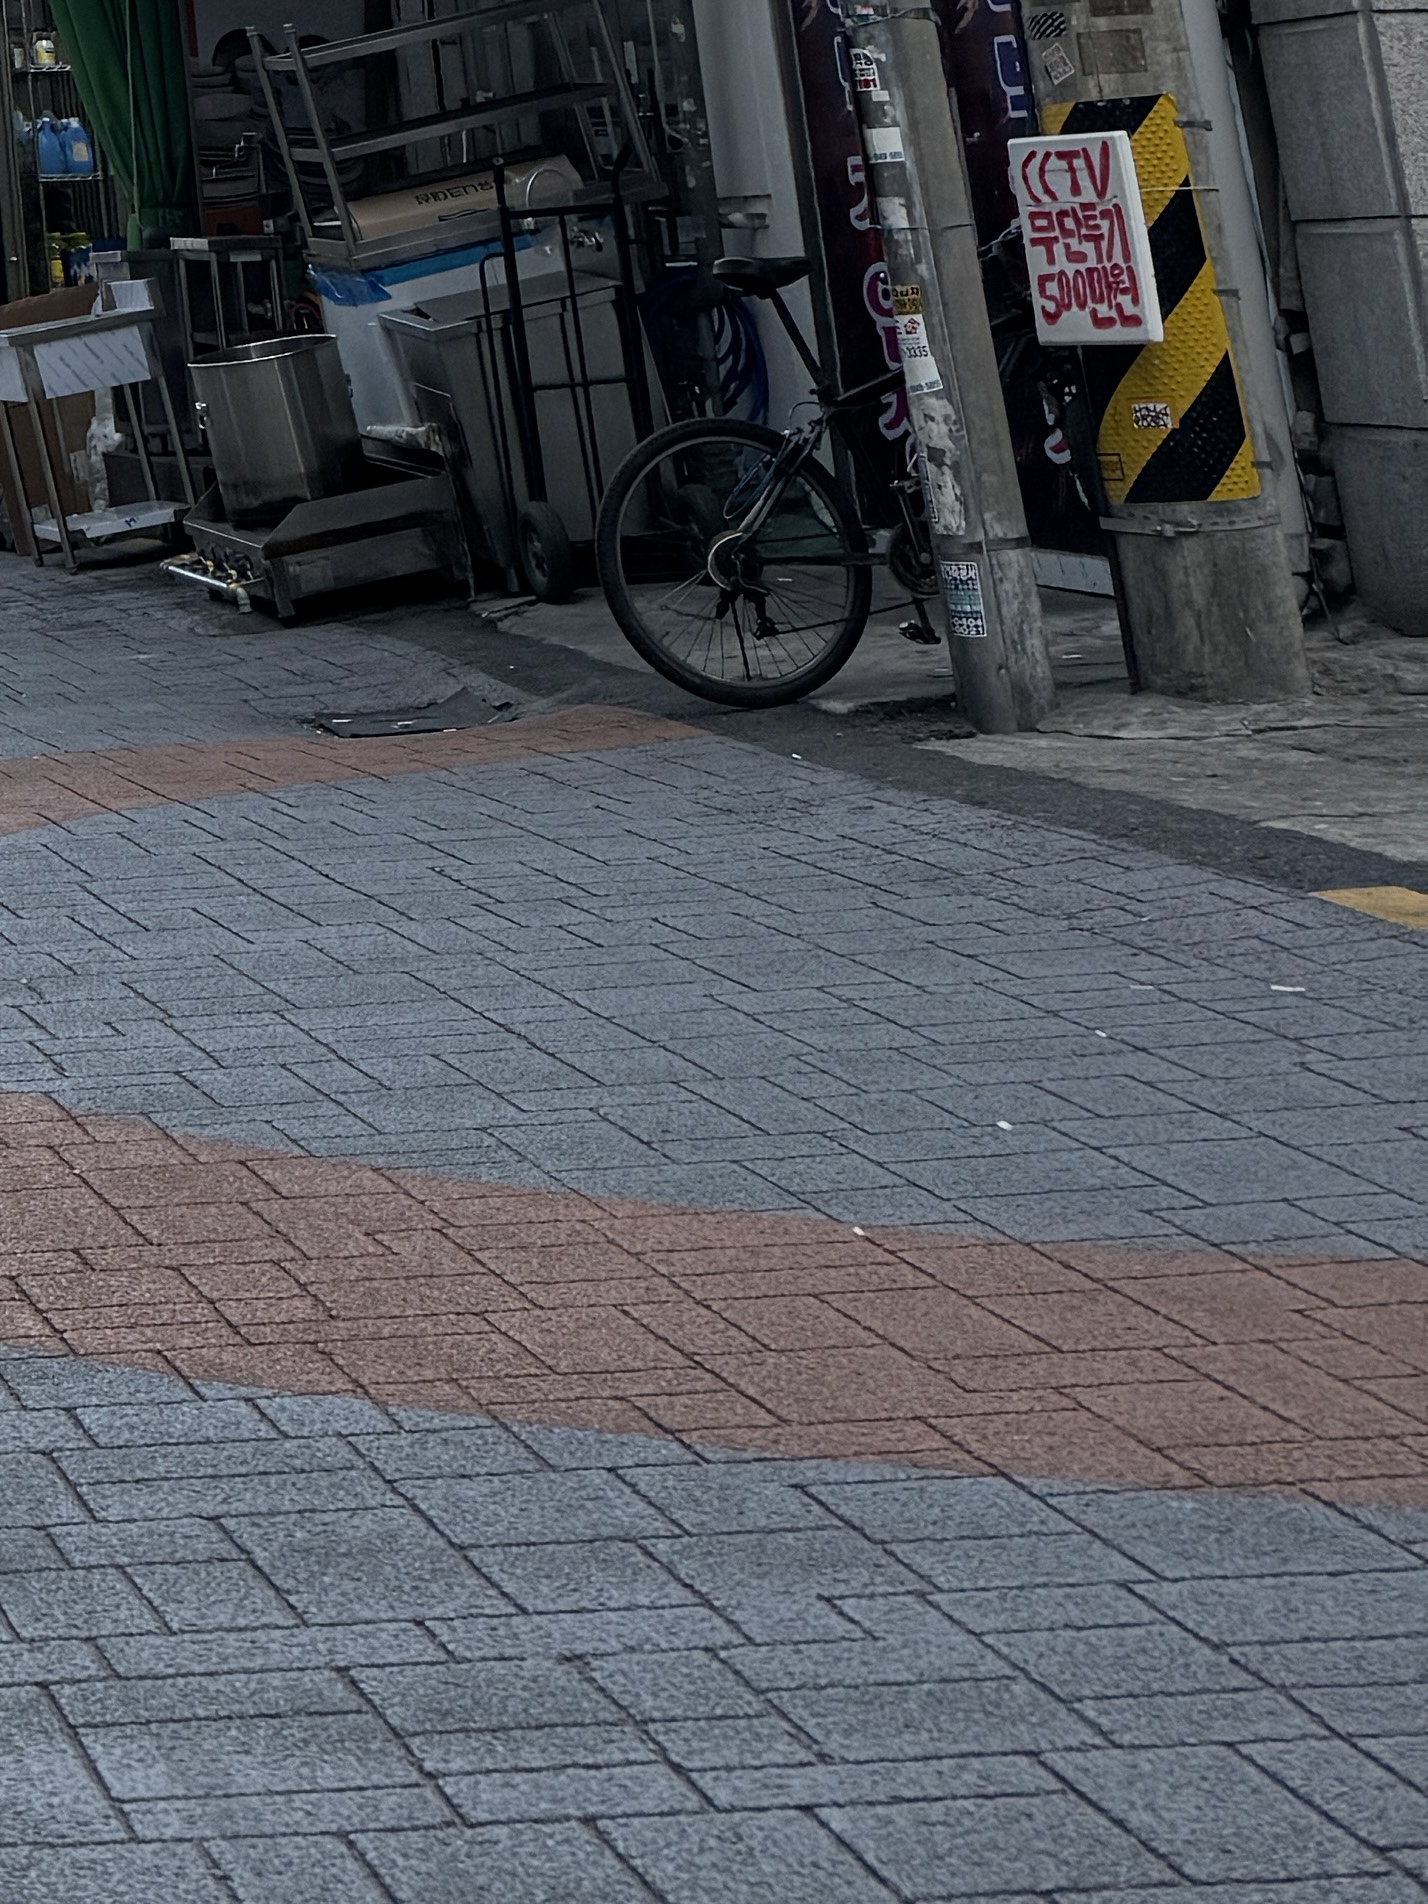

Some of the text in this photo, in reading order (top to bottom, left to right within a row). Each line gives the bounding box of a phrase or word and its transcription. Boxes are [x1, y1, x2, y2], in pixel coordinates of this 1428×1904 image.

[1021, 140, 1111, 203] CCTV
[1028, 202, 1133, 266] 무단투기
[1037, 262, 1143, 330] 500만원
